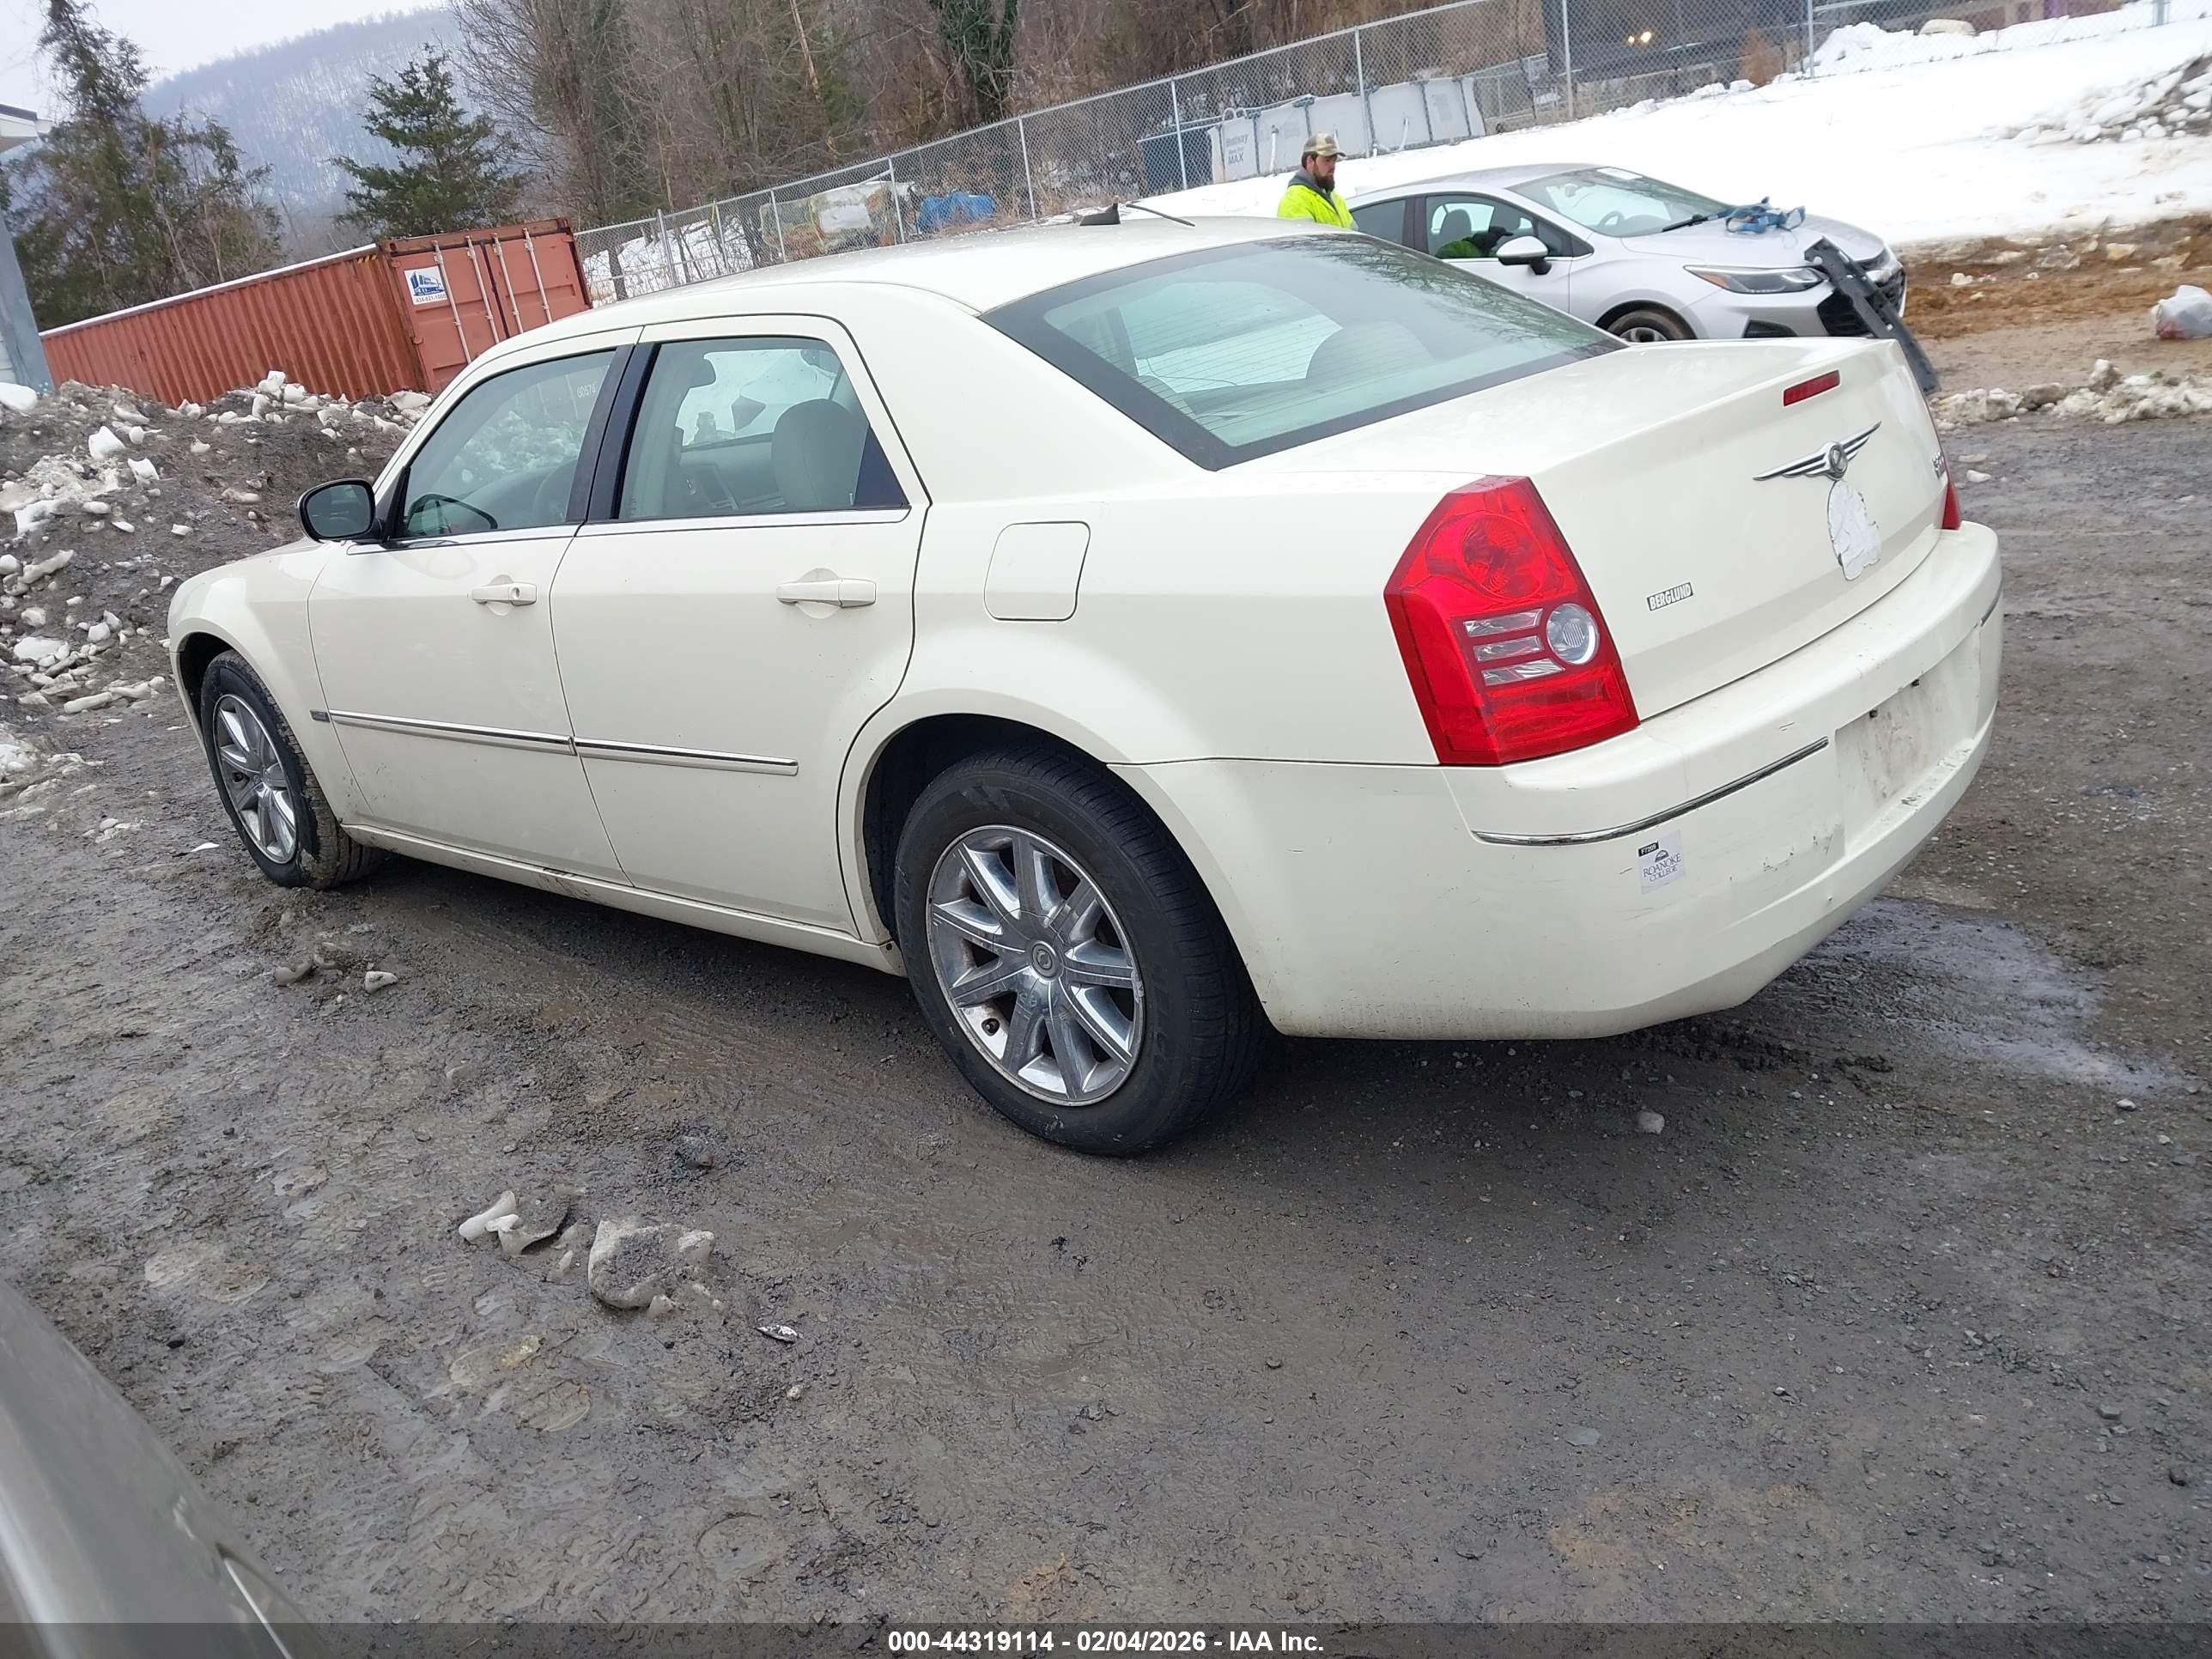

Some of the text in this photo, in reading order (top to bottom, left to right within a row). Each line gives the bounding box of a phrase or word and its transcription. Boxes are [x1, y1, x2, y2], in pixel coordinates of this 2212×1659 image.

[1649, 583, 1692, 611] BERGLUND
[1643, 853, 1682, 878] ROANOKE
[1649, 864, 1678, 883] COLLEGE
